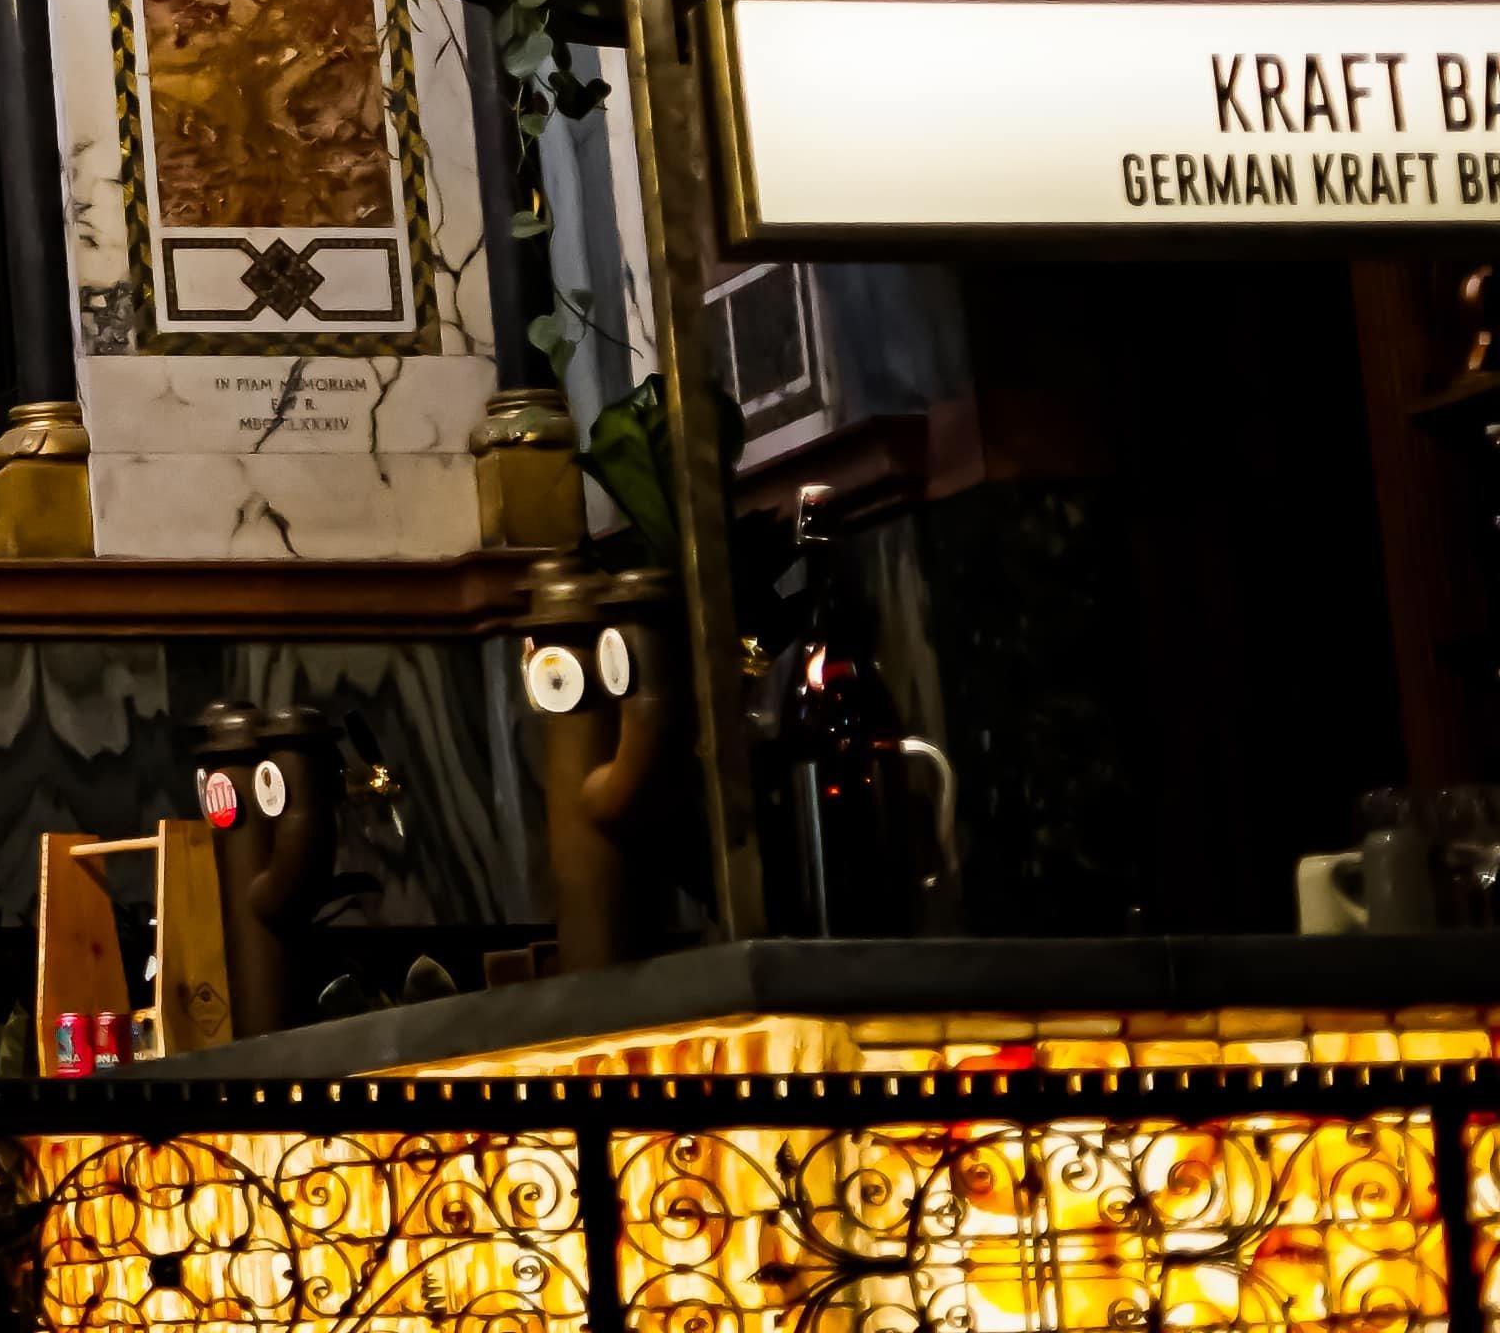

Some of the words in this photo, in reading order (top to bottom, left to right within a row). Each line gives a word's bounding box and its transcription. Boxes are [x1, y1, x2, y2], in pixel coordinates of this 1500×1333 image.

[1210, 52, 1409, 133] KRAFT
[1122, 153, 1298, 207] GERMAN
[1312, 152, 1440, 206] KRAFT
